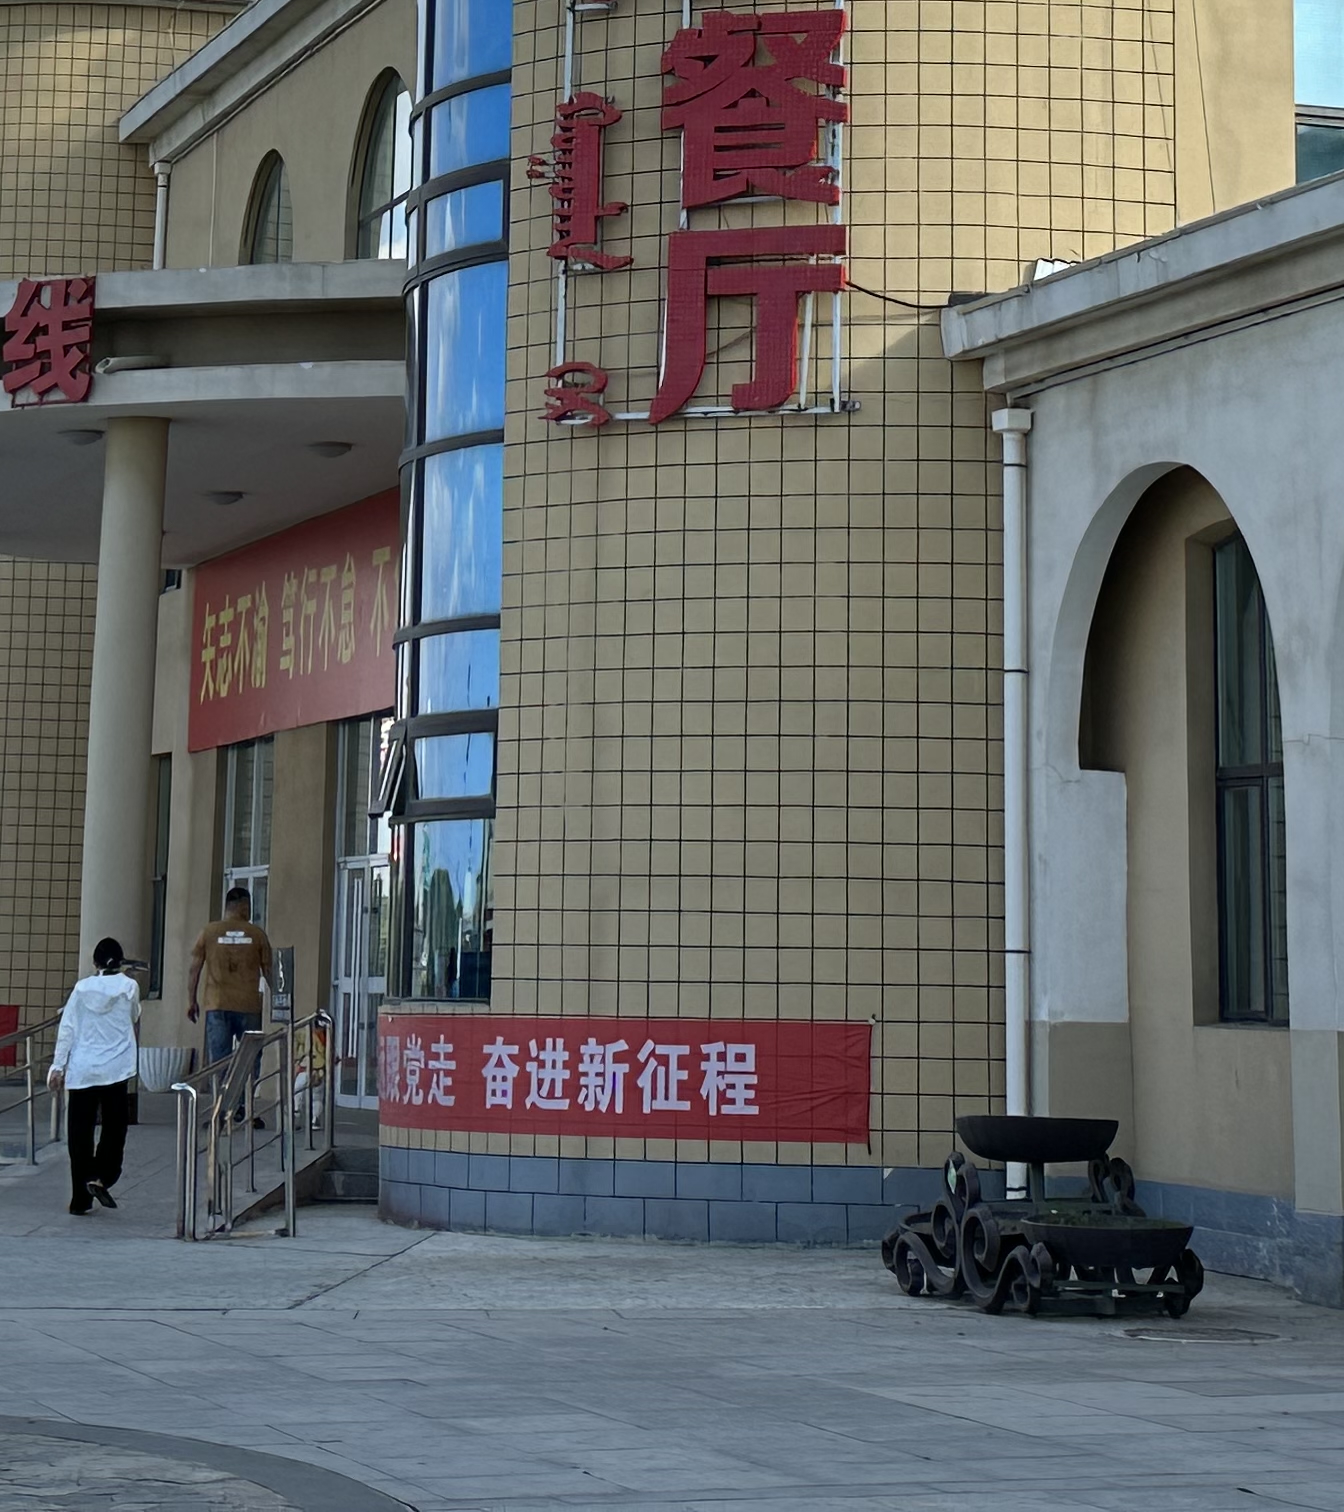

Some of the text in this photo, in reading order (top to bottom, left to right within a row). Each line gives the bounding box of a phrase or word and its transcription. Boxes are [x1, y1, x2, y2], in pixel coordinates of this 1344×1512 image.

[482, 1036, 760, 1116] 奋进新征程
